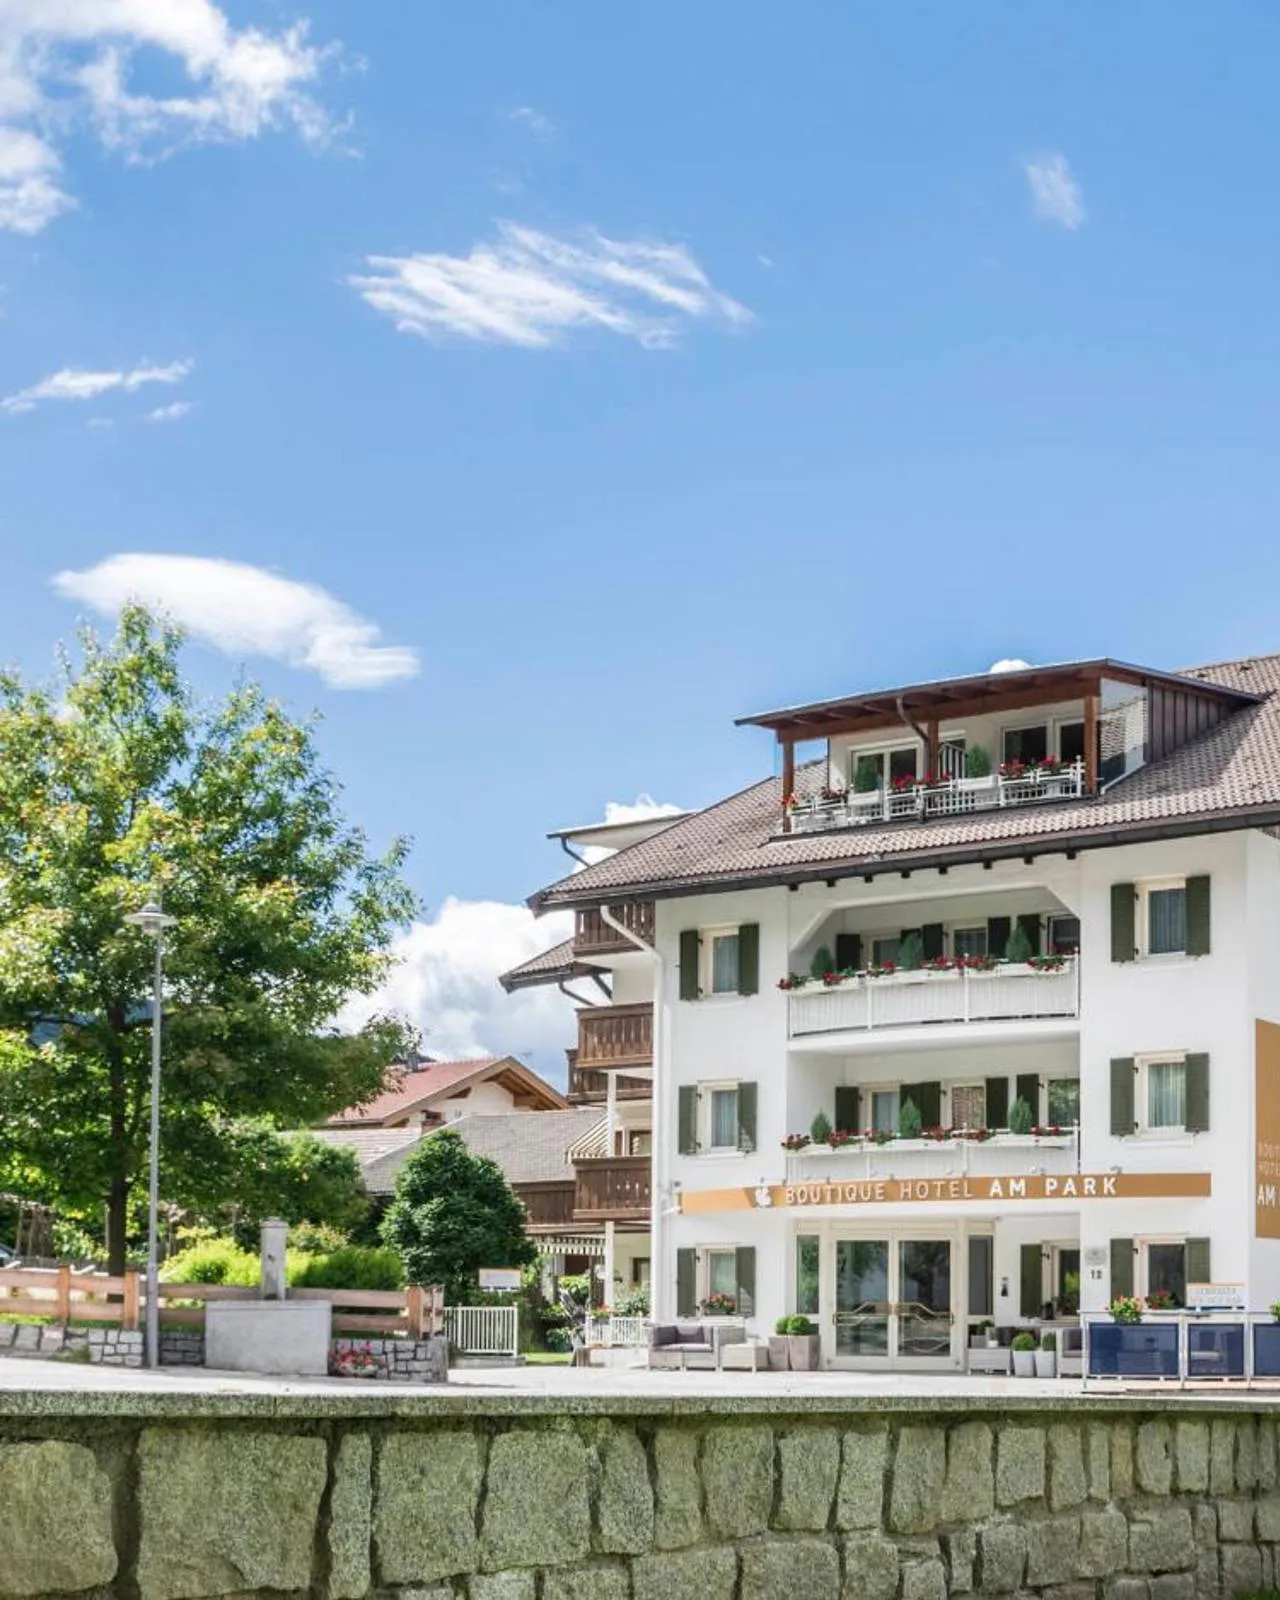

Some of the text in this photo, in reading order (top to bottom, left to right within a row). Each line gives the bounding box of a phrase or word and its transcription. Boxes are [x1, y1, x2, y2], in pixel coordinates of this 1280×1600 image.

[785, 1177, 1117, 1204] BOUTIQUE HOTEL AM PARK
[1257, 1184, 1275, 1208] AM
